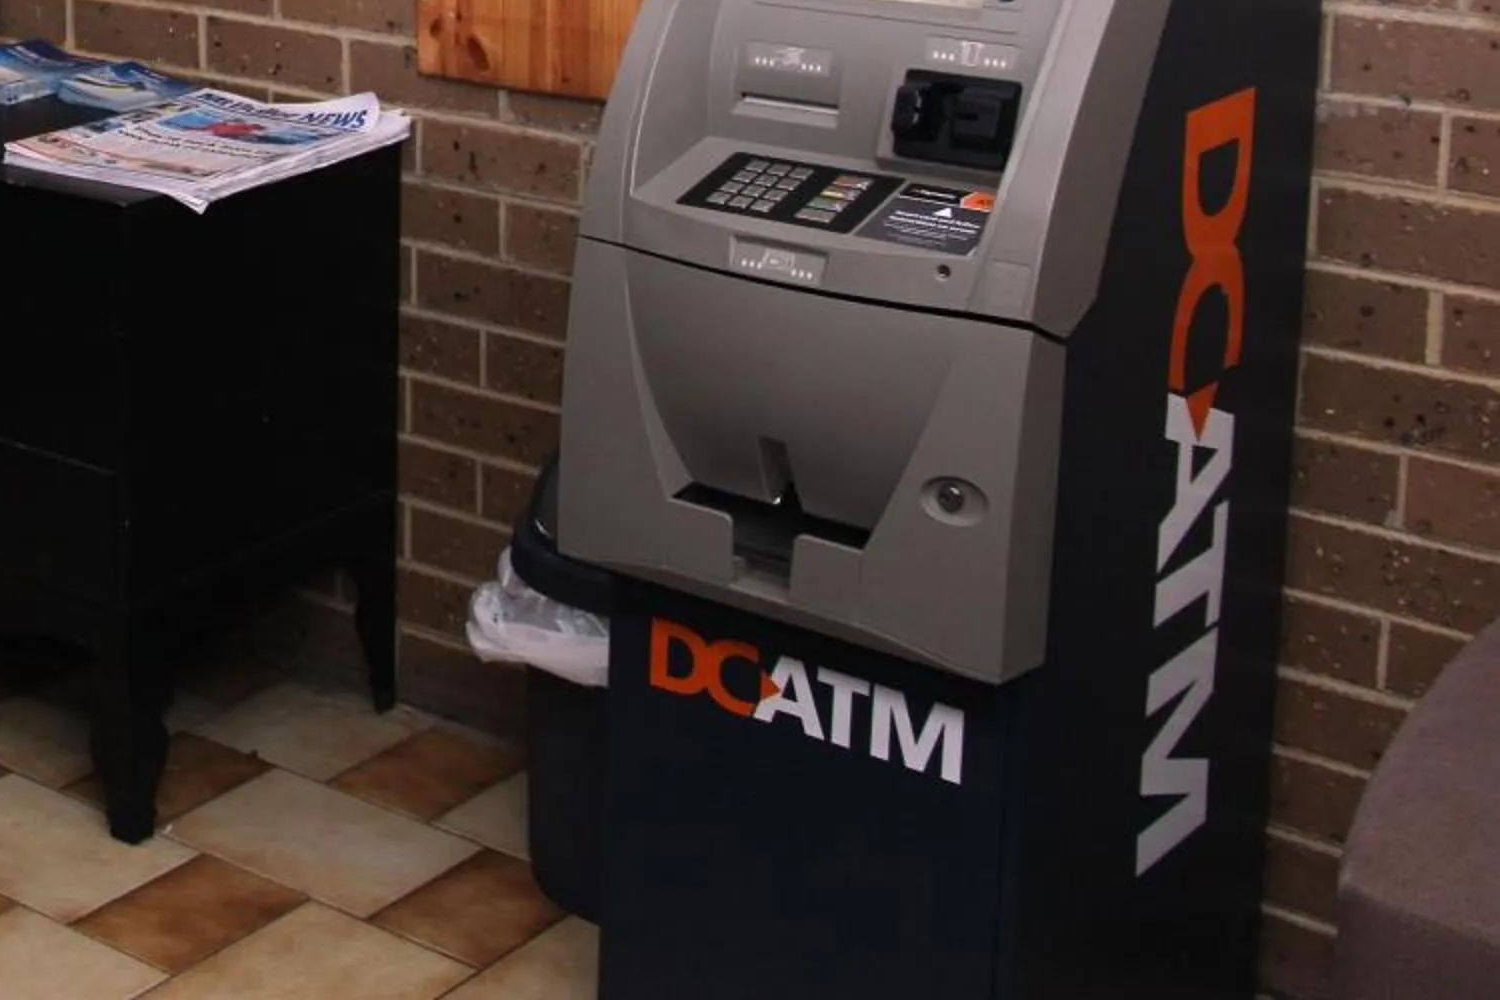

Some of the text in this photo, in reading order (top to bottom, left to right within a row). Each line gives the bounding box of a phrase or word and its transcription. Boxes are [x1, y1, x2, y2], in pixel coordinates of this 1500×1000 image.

[302, 109, 369, 130] NEWS
[1135, 87, 1257, 877] DCATM
[649, 617, 965, 786] DCATM
